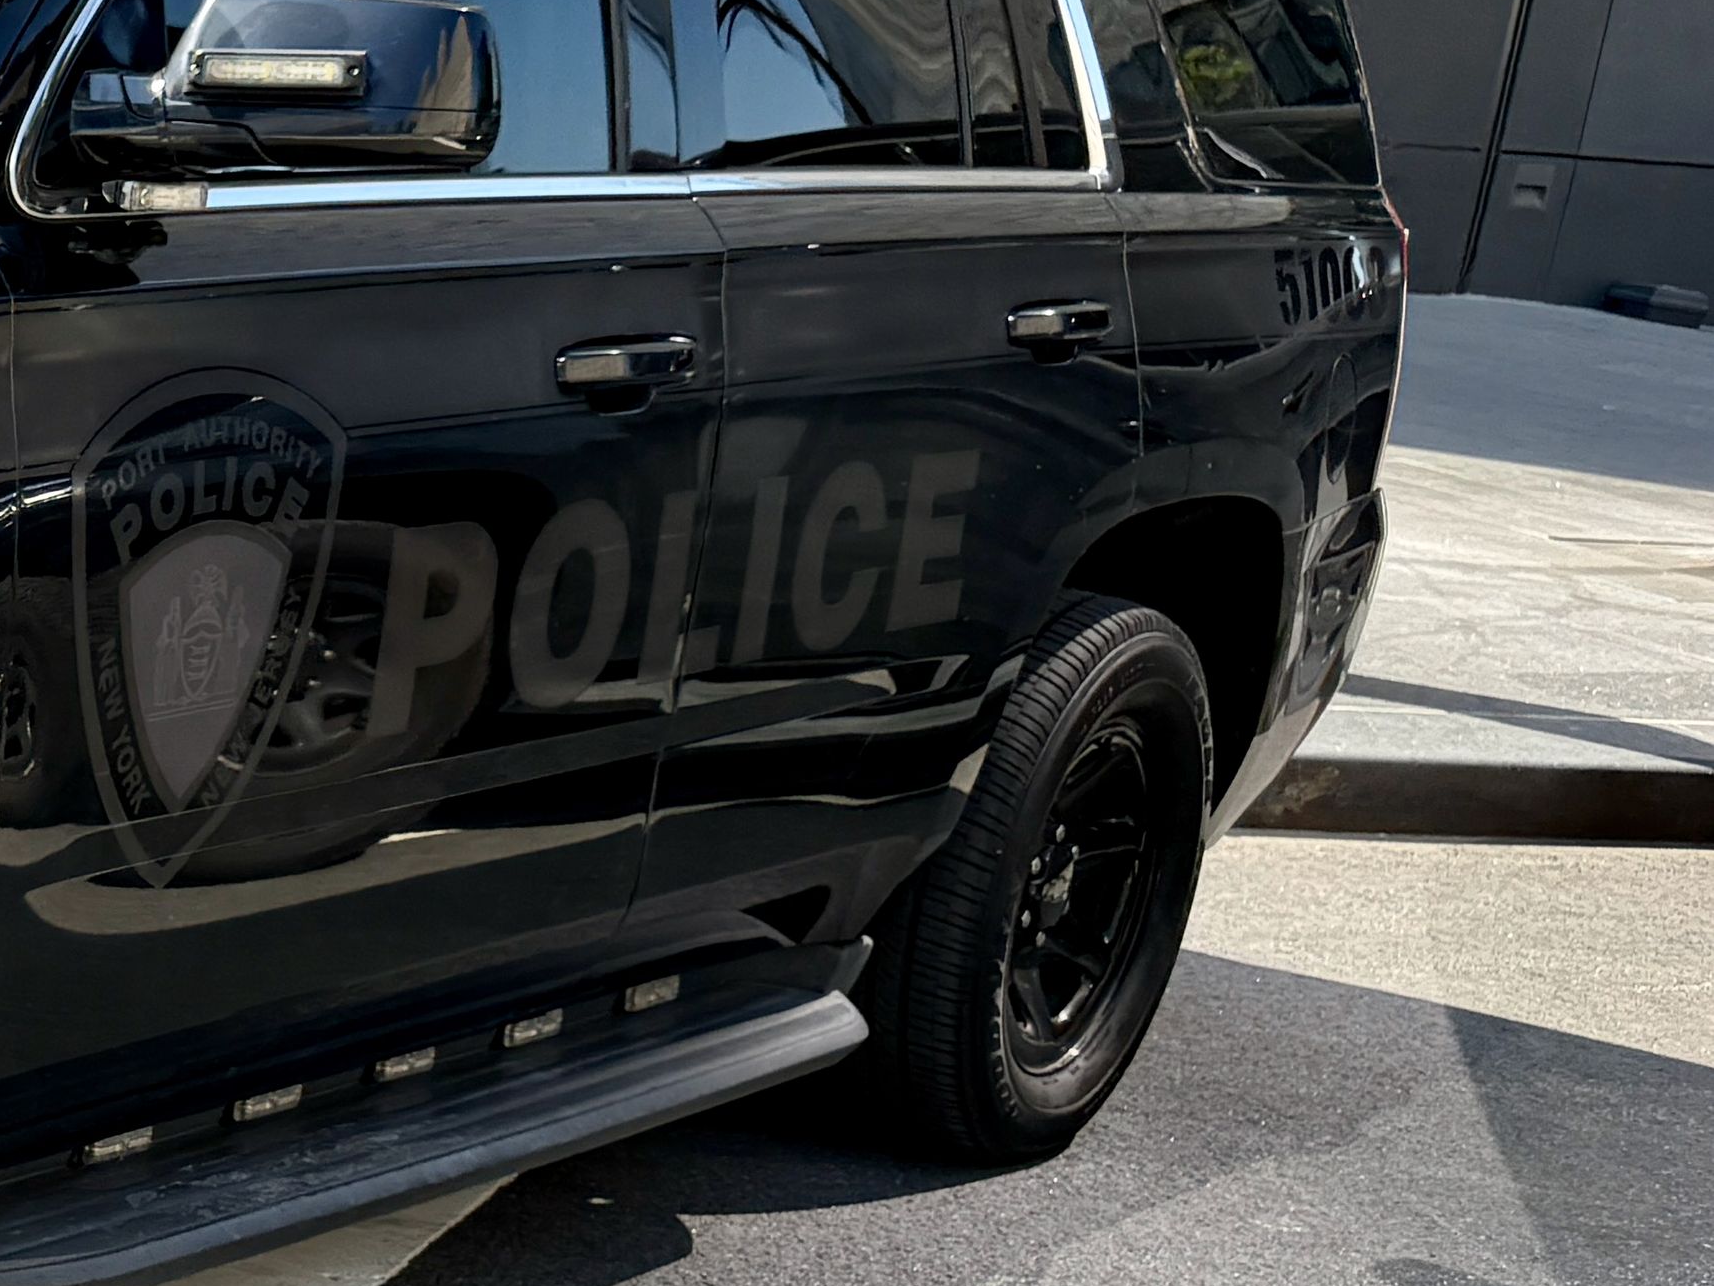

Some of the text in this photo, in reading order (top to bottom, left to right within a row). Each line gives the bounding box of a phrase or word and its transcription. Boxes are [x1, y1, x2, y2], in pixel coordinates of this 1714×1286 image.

[101, 416, 322, 511] PORT AUTHORITY
[110, 456, 310, 564] POLICE
[366, 450, 980, 736] POLICE
[97, 638, 151, 815] NEW YORK
[201, 737, 251, 807] NEW
